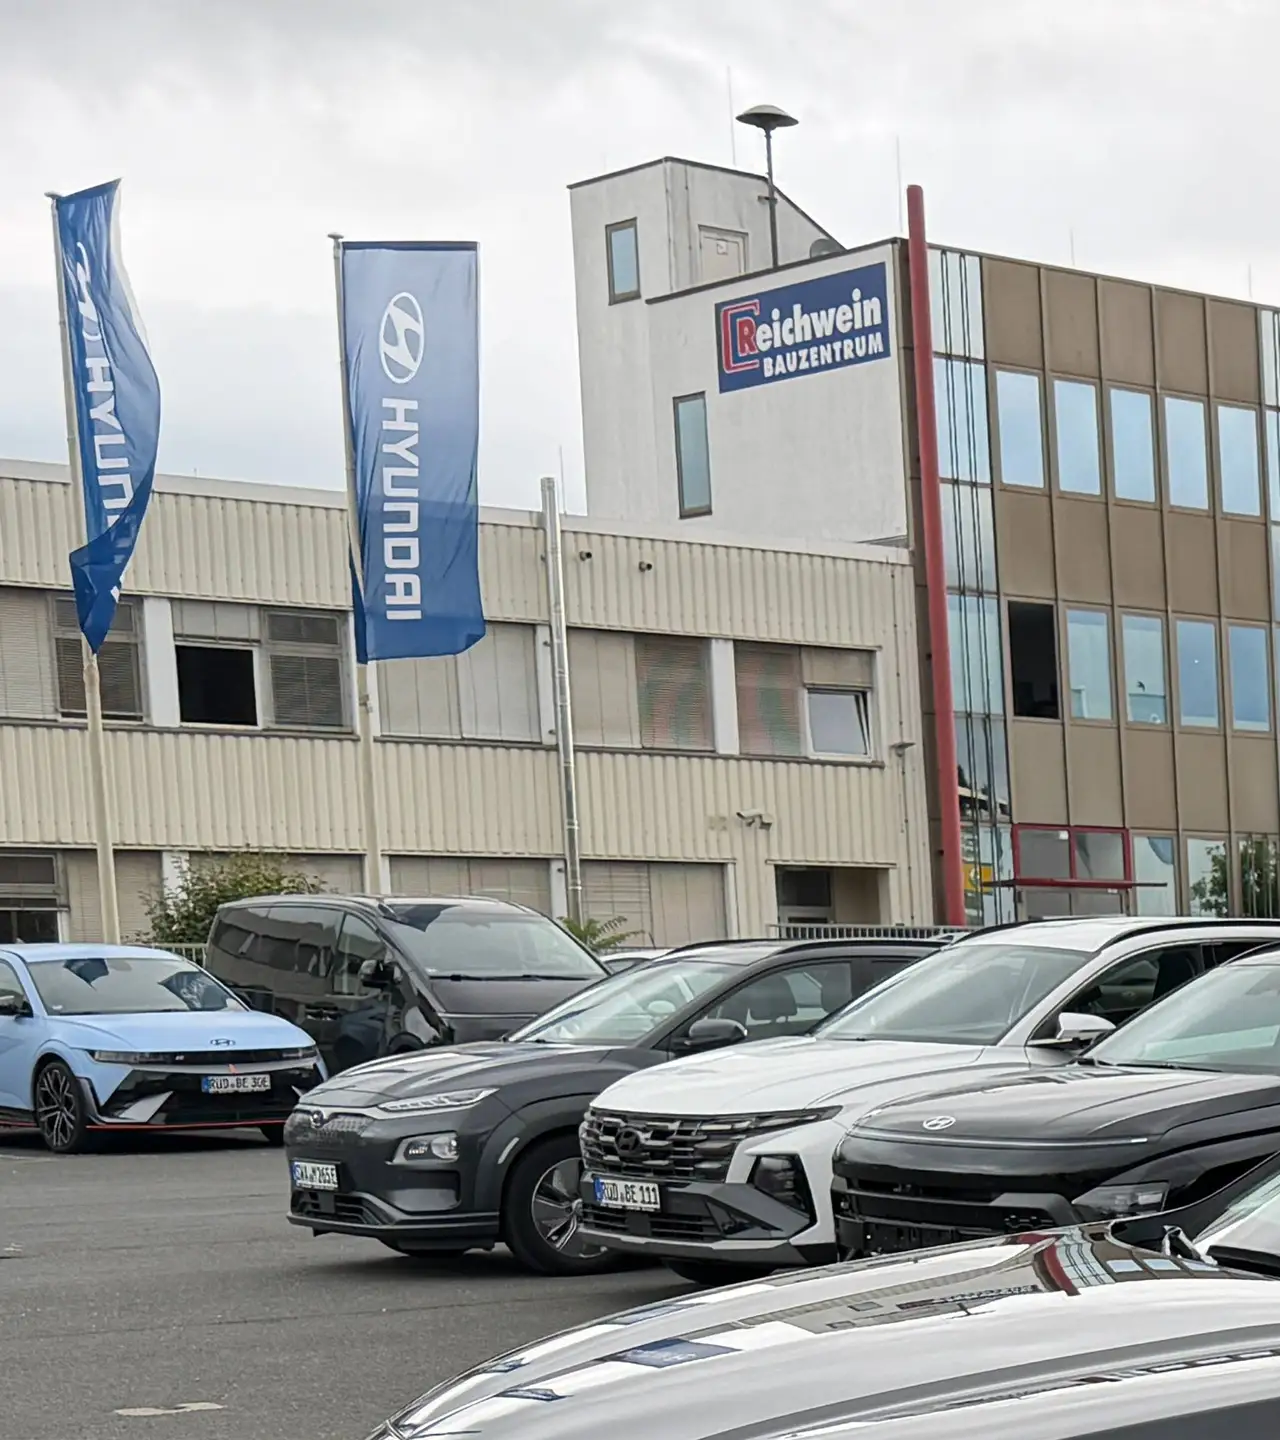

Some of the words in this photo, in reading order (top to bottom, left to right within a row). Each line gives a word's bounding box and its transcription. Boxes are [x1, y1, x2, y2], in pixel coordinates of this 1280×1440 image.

[735, 288, 882, 357] Reichwein
[763, 332, 884, 378] BAUZENTRUM
[85, 357, 134, 528] HYUN
[382, 398, 422, 619] HYUNDAI
[639, 1185, 659, 1205] 111
